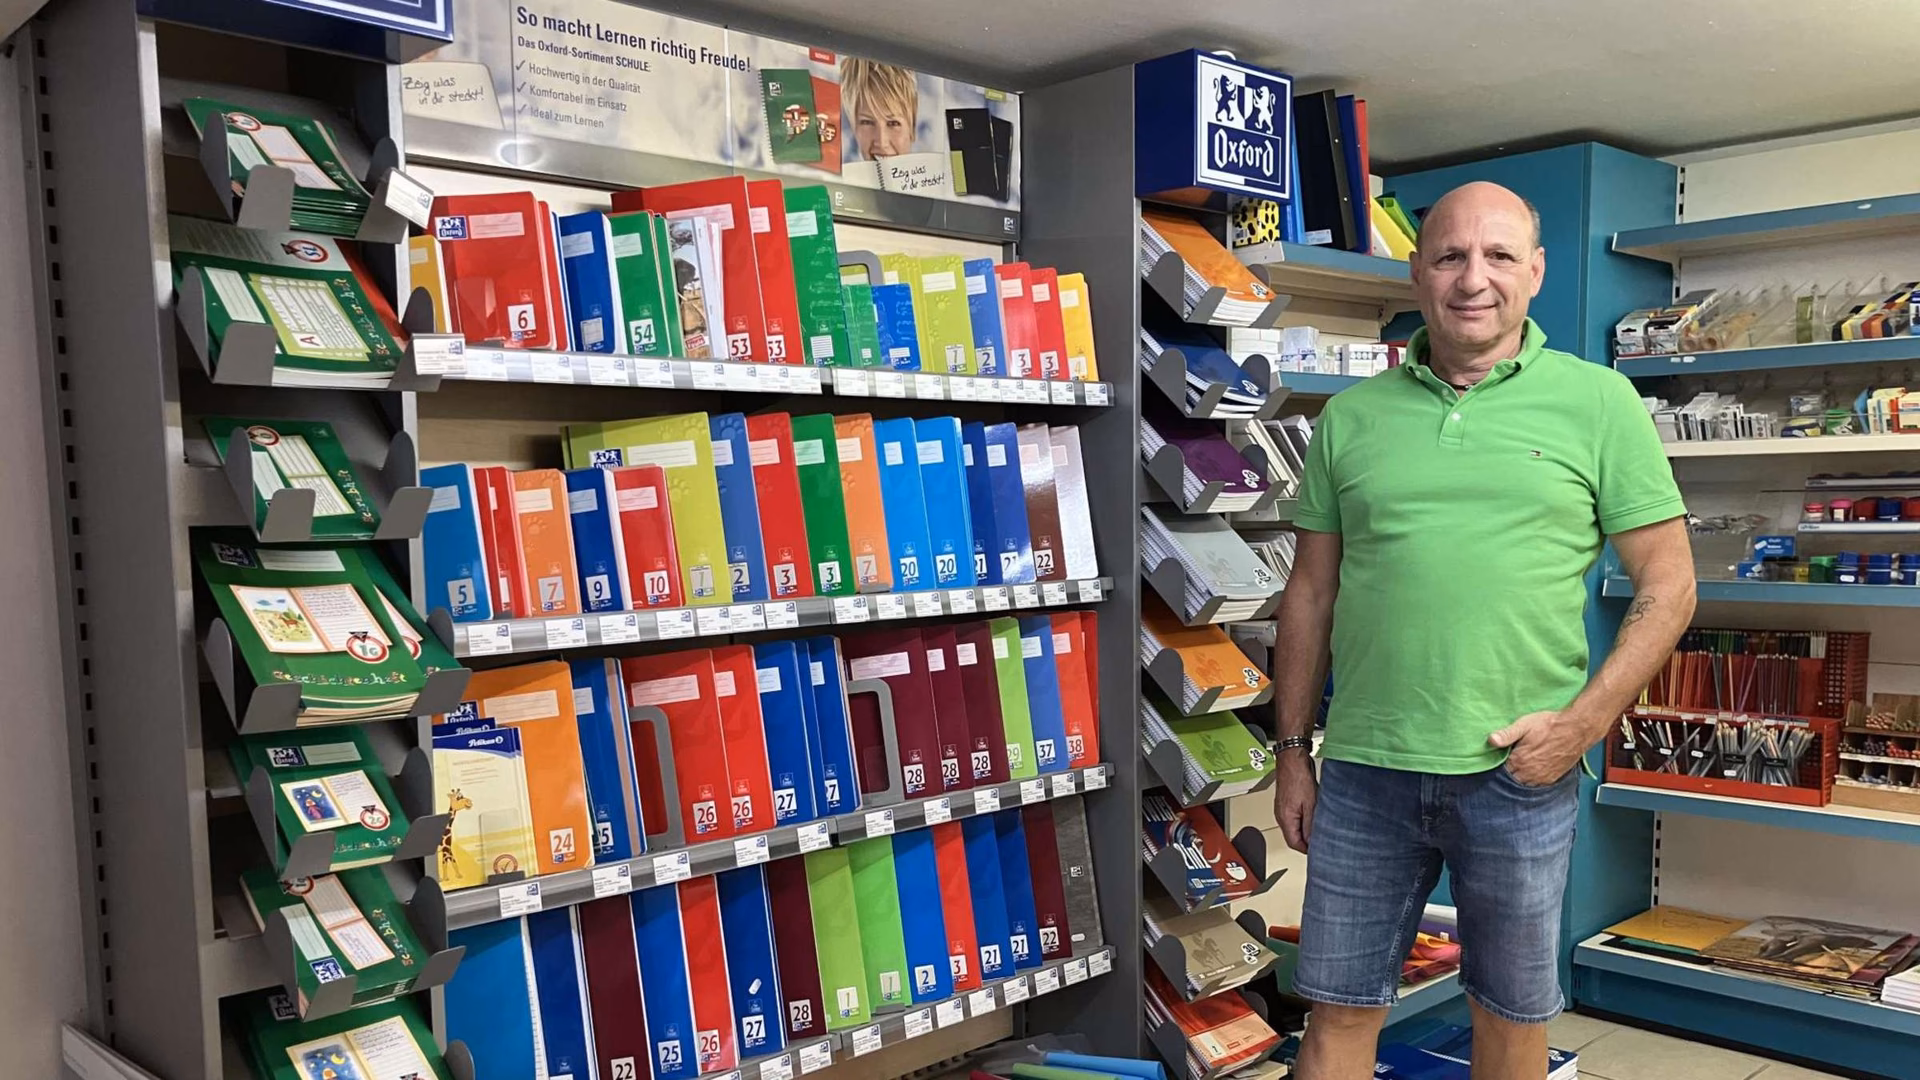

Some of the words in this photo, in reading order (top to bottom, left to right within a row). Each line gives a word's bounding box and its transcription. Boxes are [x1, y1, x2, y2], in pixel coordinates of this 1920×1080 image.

[517, 6, 538, 27] So
[543, 16, 592, 38] macht
[597, 23, 646, 49] Lernen
[651, 37, 696, 64] richtig
[701, 47, 751, 72] Freude!
[518, 36, 535, 49] Das
[538, 40, 614, 65] Oxford-Sortiment
[529, 63, 580, 85] Hochwertig
[582, 73, 590, 84] in
[592, 76, 606, 87] der
[609, 78, 641, 93] Qualität
[529, 85, 583, 104] Komfortabel
[585, 97, 596, 106] im
[598, 97, 627, 112] Einsatz
[530, 107, 553, 120] Ideal
[554, 112, 572, 123] zum
[574, 114, 604, 128] Lernen
[1214, 128, 1274, 177] Oxford
[517, 310, 528, 329] 6
[634, 323, 653, 344] 54
[731, 338, 749, 356] 53
[982, 352, 991, 366] 2
[1018, 353, 1027, 367] 3
[1045, 356, 1054, 370] 3
[863, 560, 872, 575] 7
[902, 562, 916, 577] 20
[939, 558, 954, 574] 20
[1037, 553, 1051, 569] 22
[734, 568, 743, 584] 2
[781, 569, 790, 585] 3
[826, 567, 835, 583] 3
[547, 582, 558, 600] 7
[593, 581, 603, 599] 9
[649, 575, 666, 594] 10
[458, 585, 467, 605] 5
[467, 738, 496, 748] Pelikan
[1039, 743, 1052, 759] 37
[1068, 738, 1082, 754] 38
[943, 762, 957, 778] 28
[974, 754, 989, 771] 28
[907, 768, 923, 784] 28
[733, 800, 750, 817] 26
[777, 793, 794, 812] 27
[697, 805, 715, 824] 26
[553, 834, 573, 853] 24
[1013, 938, 1026, 954] 21
[1043, 931, 1057, 946] 22
[985, 949, 999, 965] 21
[954, 959, 961, 974] 3
[922, 970, 929, 985] 2
[793, 1004, 810, 1022] 28
[746, 1020, 763, 1038] 27
[701, 1034, 718, 1052] 26
[662, 1045, 680, 1063] 25
[615, 1062, 633, 1080] 22
